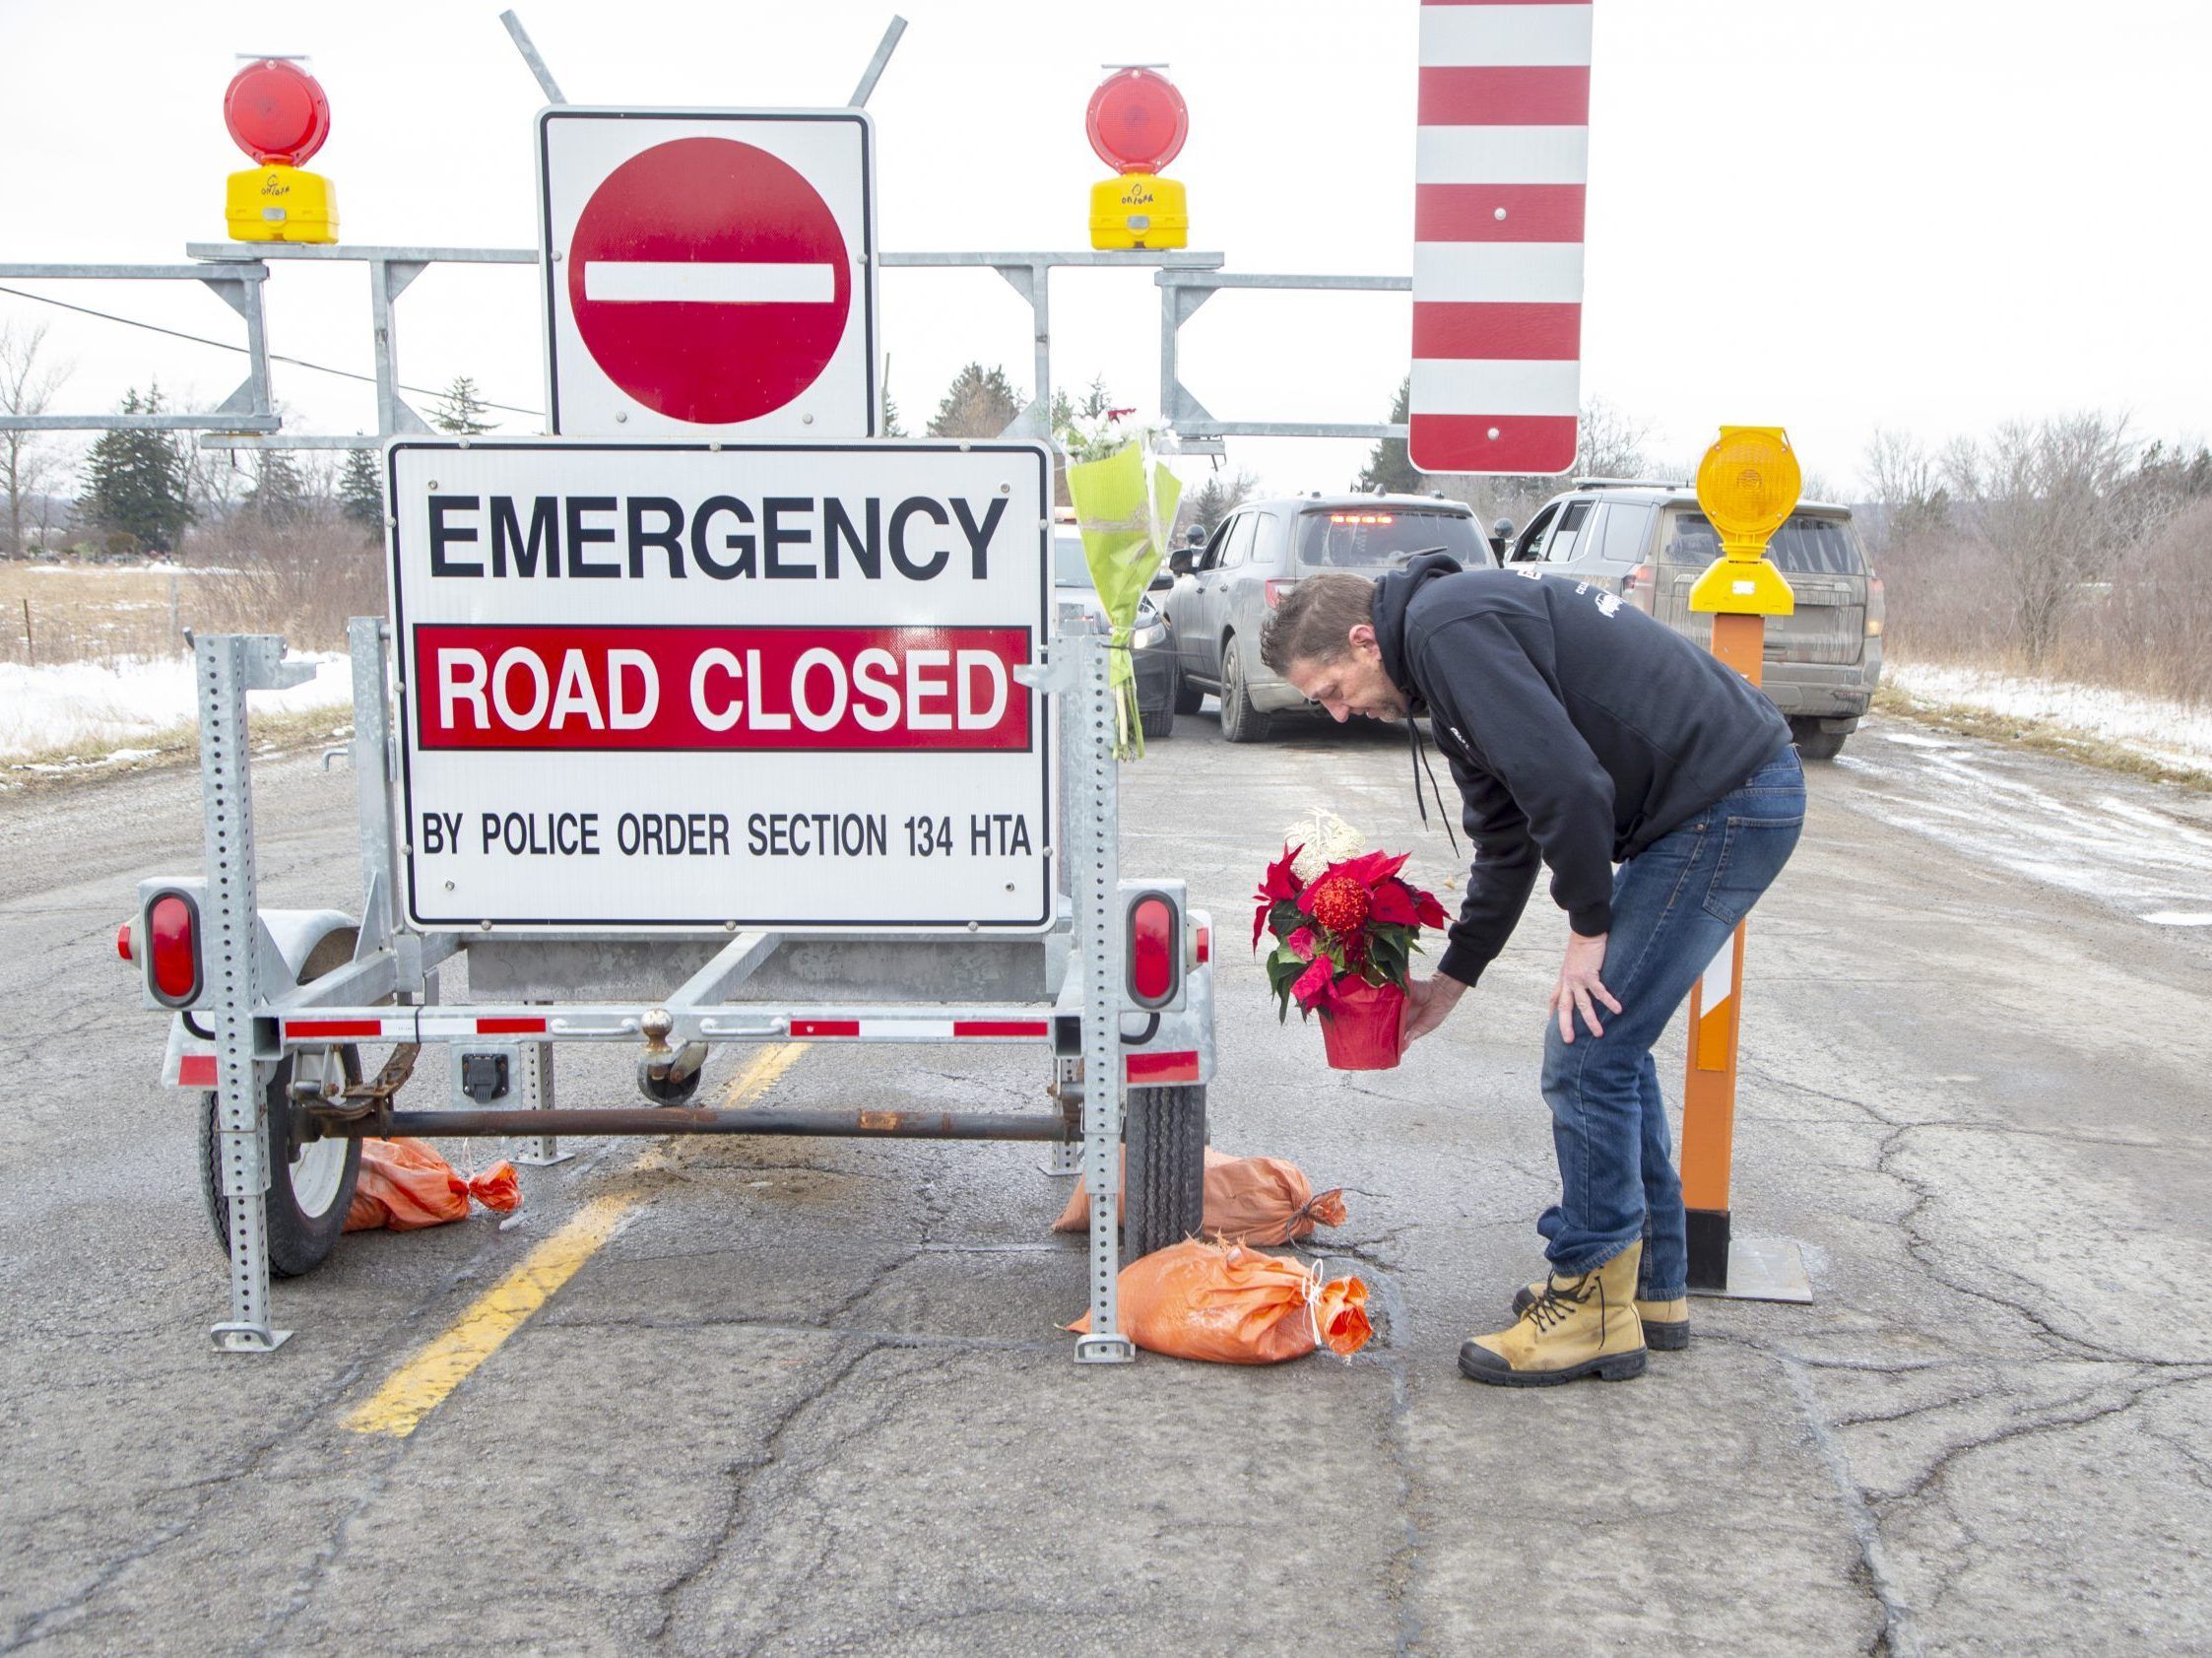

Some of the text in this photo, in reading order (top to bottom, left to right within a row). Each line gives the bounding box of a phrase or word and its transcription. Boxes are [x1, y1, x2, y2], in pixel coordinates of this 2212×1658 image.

[427, 495, 1009, 581] EMERGENCY
[437, 646, 1008, 732] ROAD CLOSED
[423, 812, 1032, 857] BY POLICE ORDER SECTION 134 HTA
